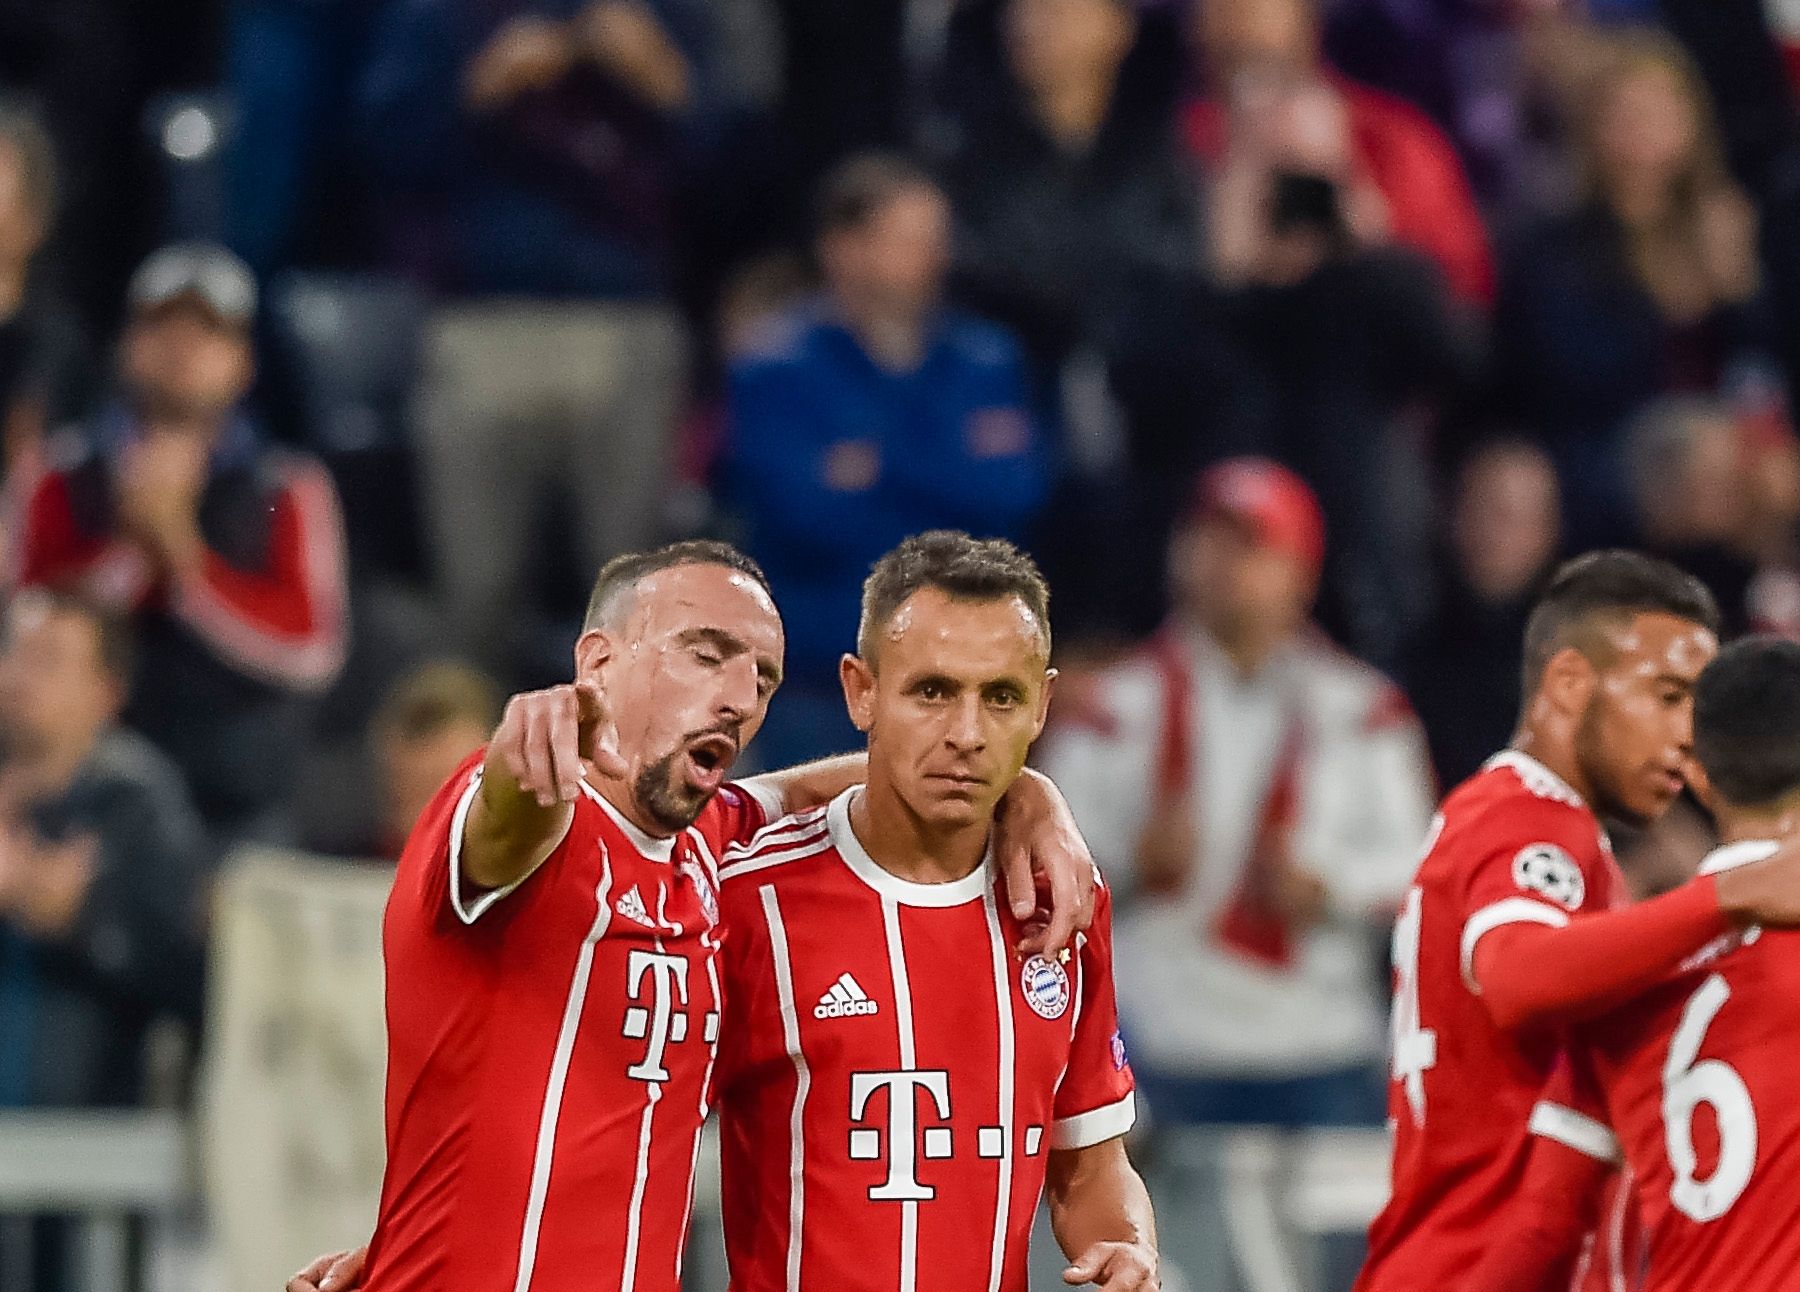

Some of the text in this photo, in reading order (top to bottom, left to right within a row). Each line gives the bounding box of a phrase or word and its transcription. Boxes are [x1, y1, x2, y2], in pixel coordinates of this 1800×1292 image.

[628, 950, 689, 1081] T
[813, 1000, 878, 1019] adidas
[851, 1071, 950, 1200] T
[1662, 972, 1758, 1222] 6
